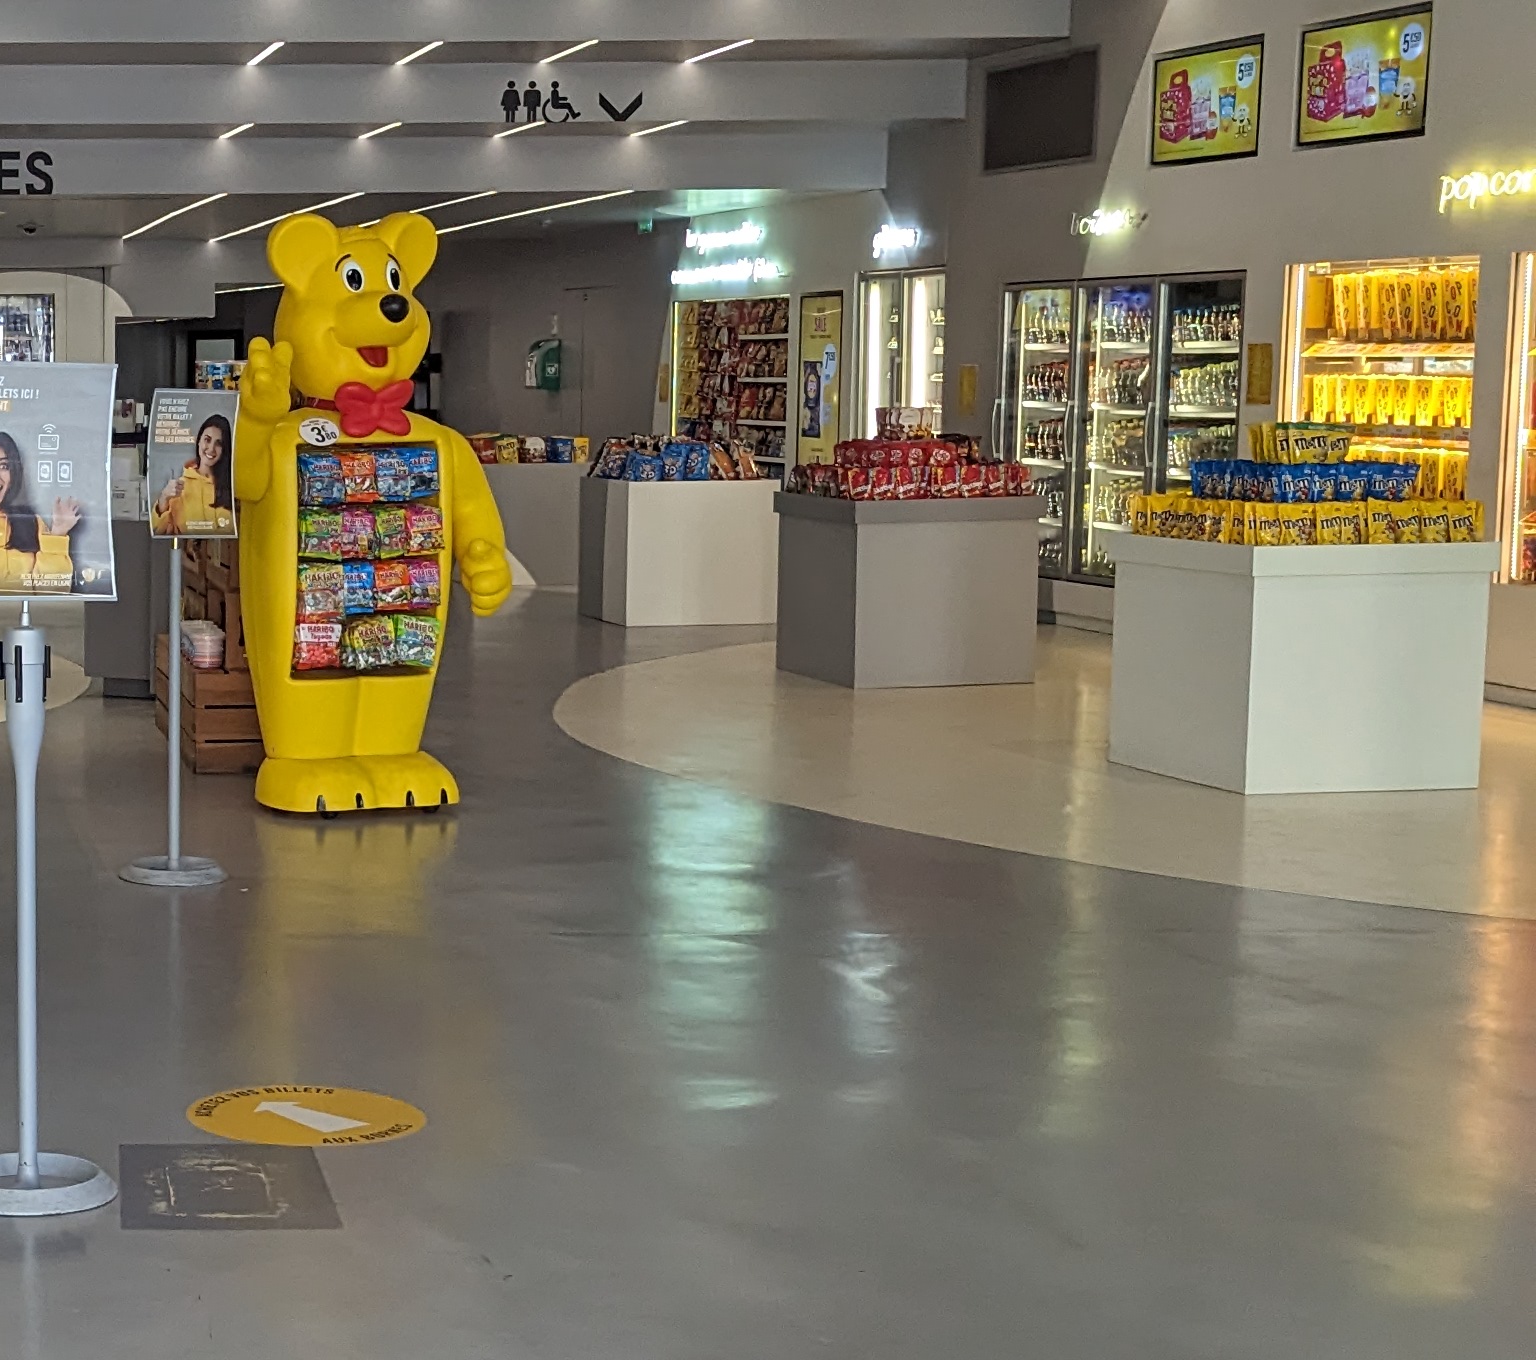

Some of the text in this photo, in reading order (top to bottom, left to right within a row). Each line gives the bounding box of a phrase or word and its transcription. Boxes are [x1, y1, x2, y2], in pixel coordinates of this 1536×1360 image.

[21, 389, 34, 399] ICI
[307, 625, 335, 633] HARIBO
[404, 621, 434, 632] HARIBO
[263, 1087, 336, 1096] BILLETS
[321, 1136, 358, 1145] AUX
